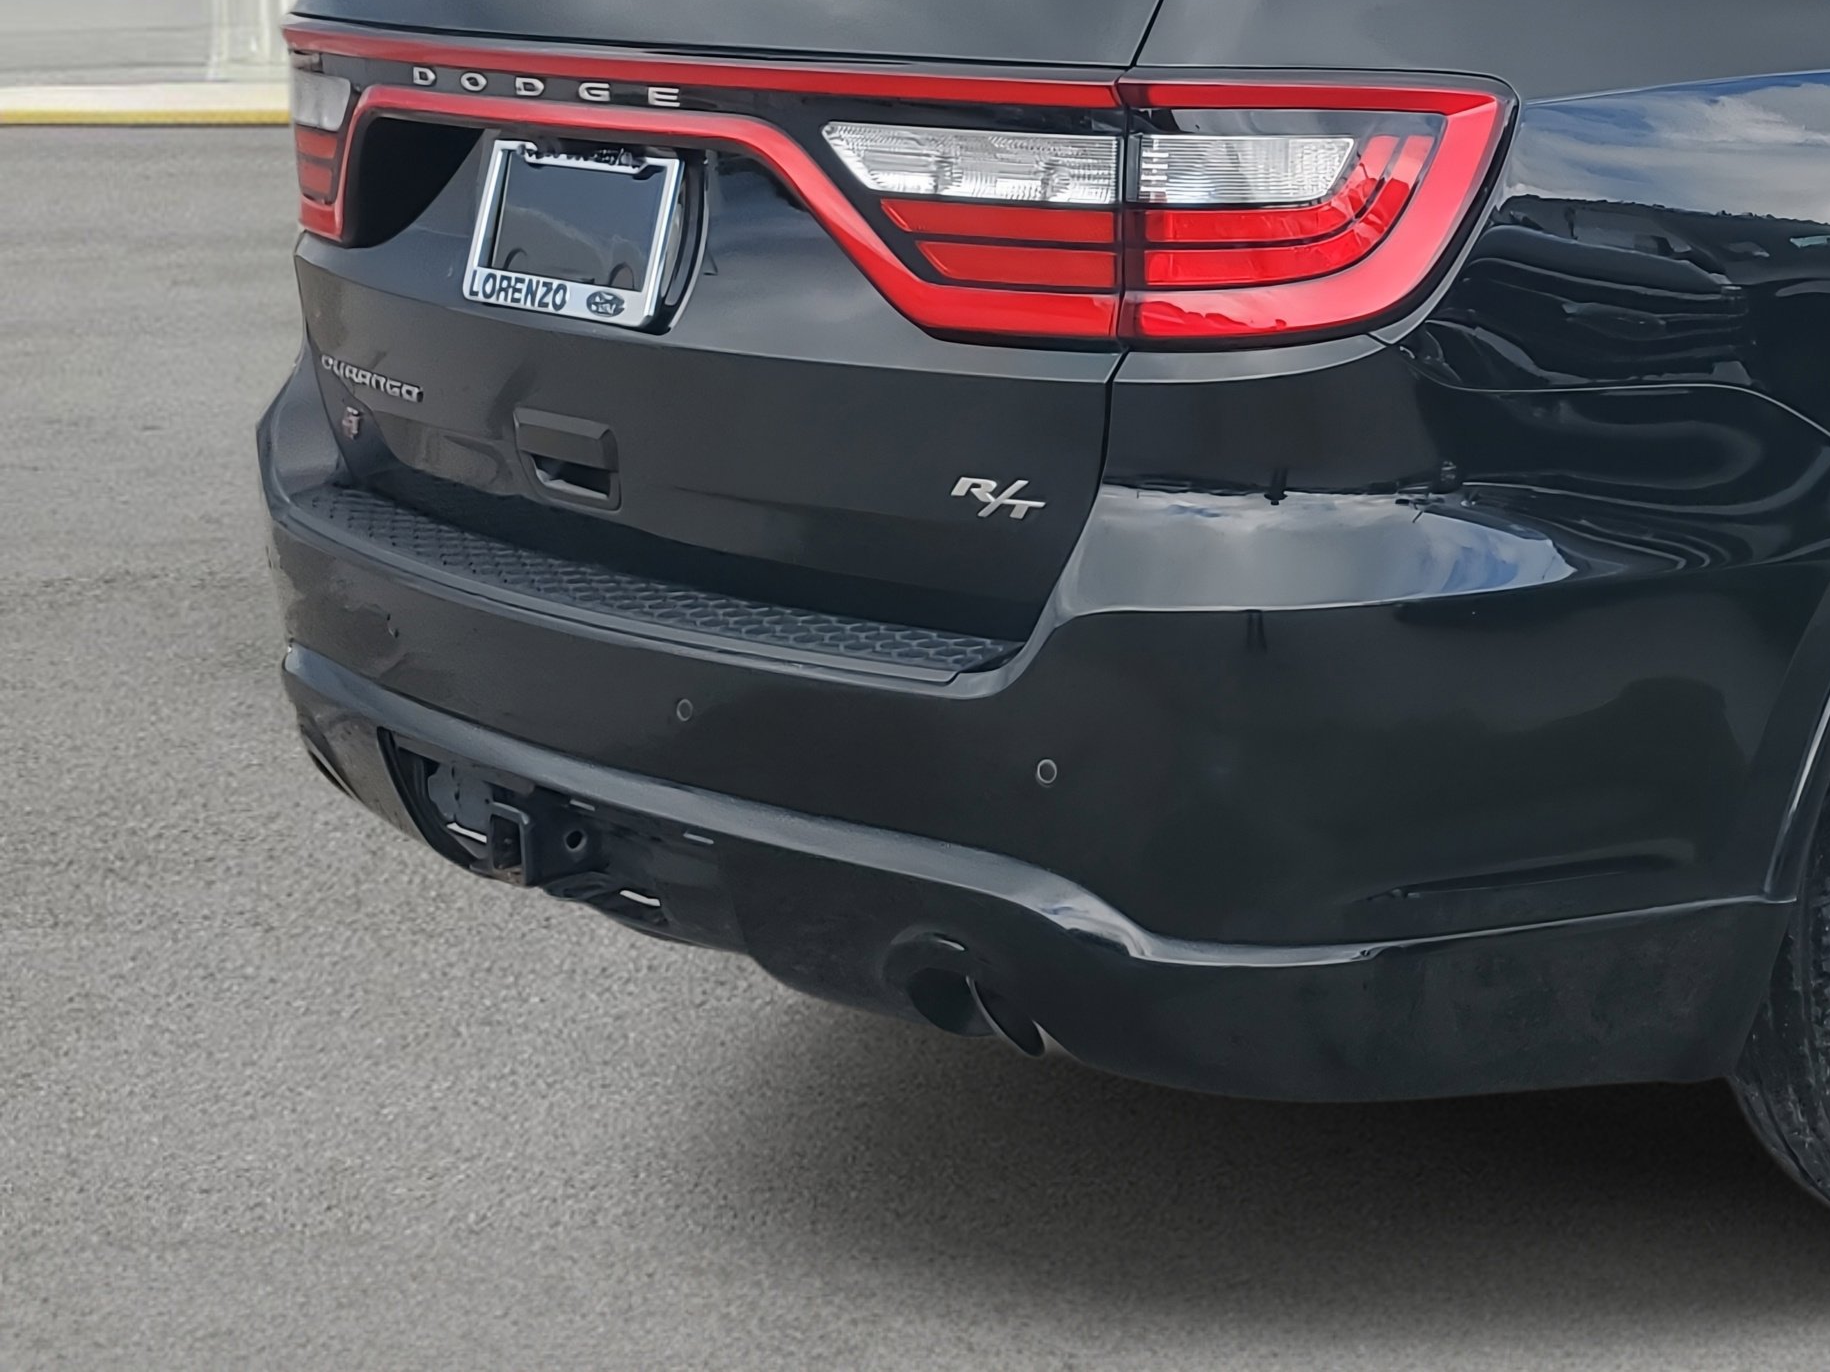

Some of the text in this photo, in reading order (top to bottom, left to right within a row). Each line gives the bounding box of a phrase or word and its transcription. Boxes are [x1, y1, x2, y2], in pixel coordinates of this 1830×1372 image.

[412, 65, 681, 107] DODGE
[468, 269, 568, 312] LORENZO
[321, 354, 423, 403] DURANGO
[950, 476, 1046, 520] R/T
